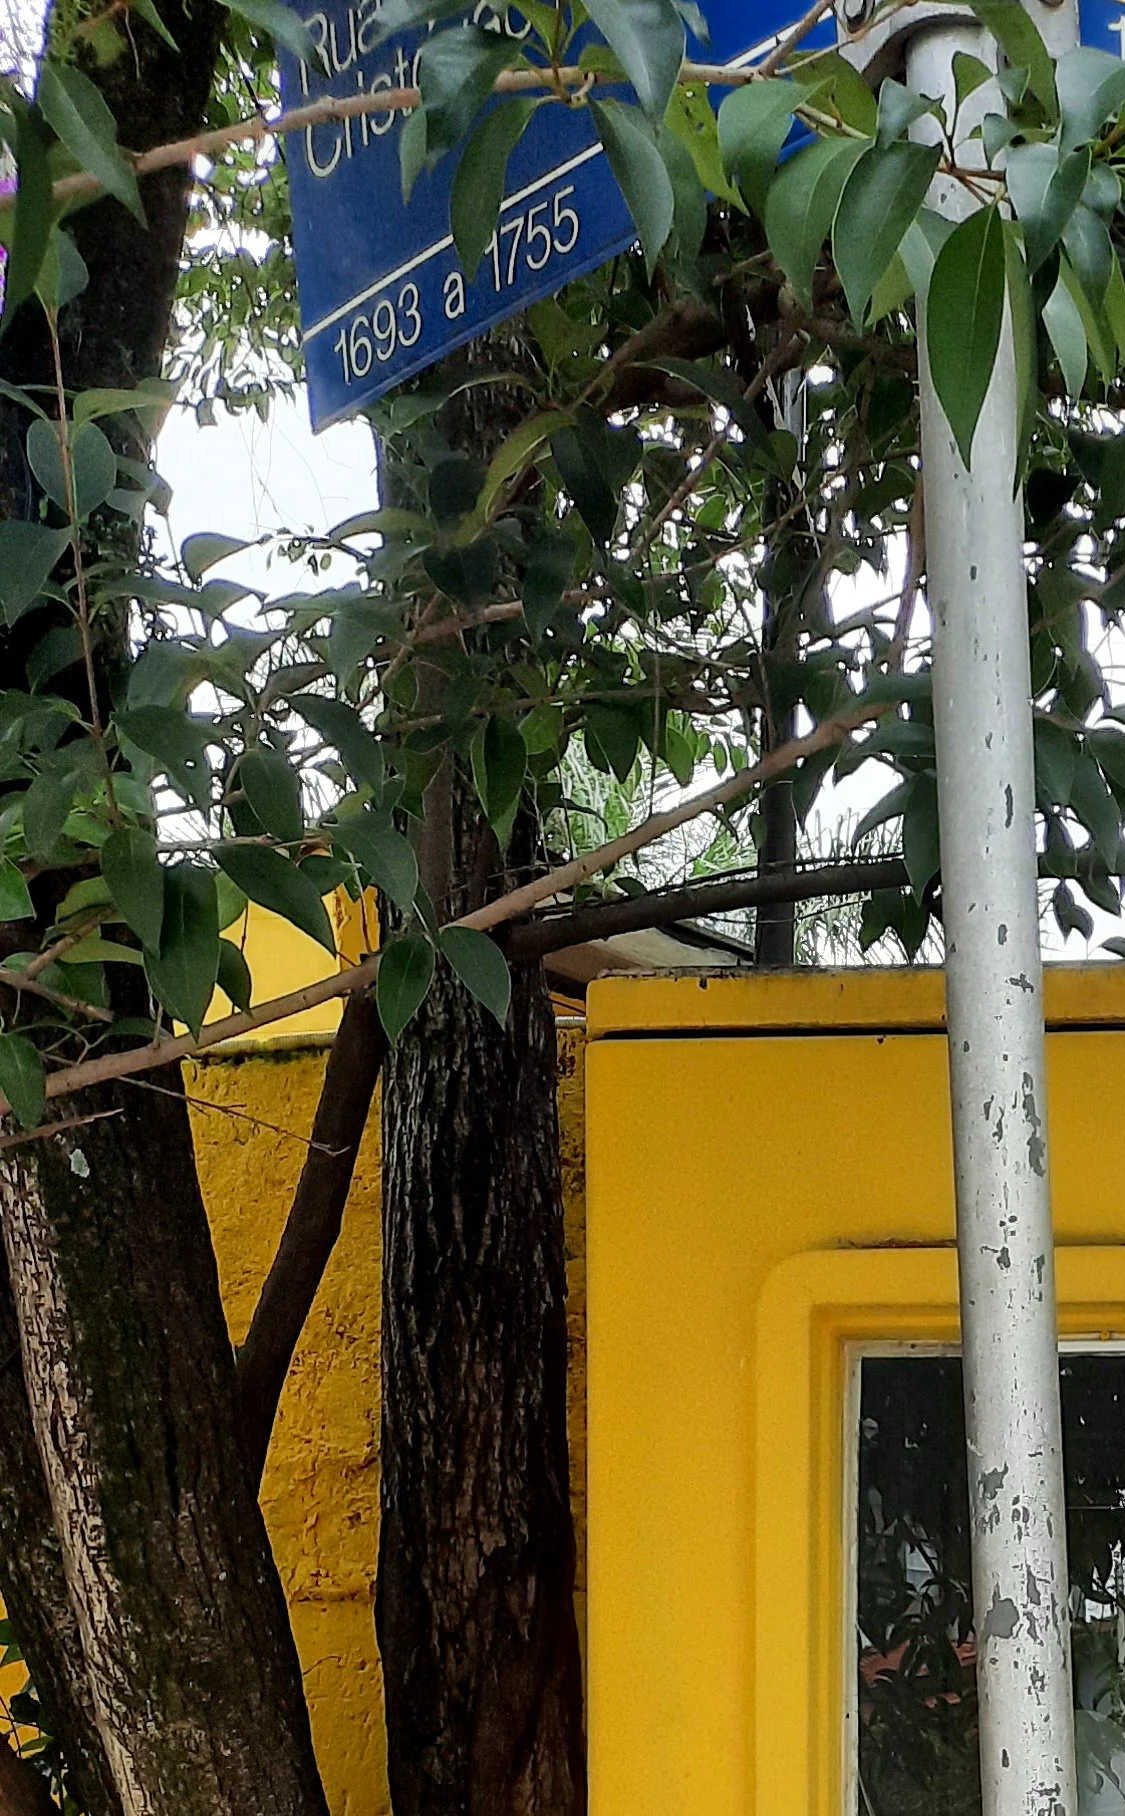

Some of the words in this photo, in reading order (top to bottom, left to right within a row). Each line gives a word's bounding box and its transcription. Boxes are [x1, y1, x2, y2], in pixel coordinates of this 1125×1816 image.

[334, 282, 422, 386] 1693
[443, 271, 466, 319] a
[485, 184, 579, 292] 1755
